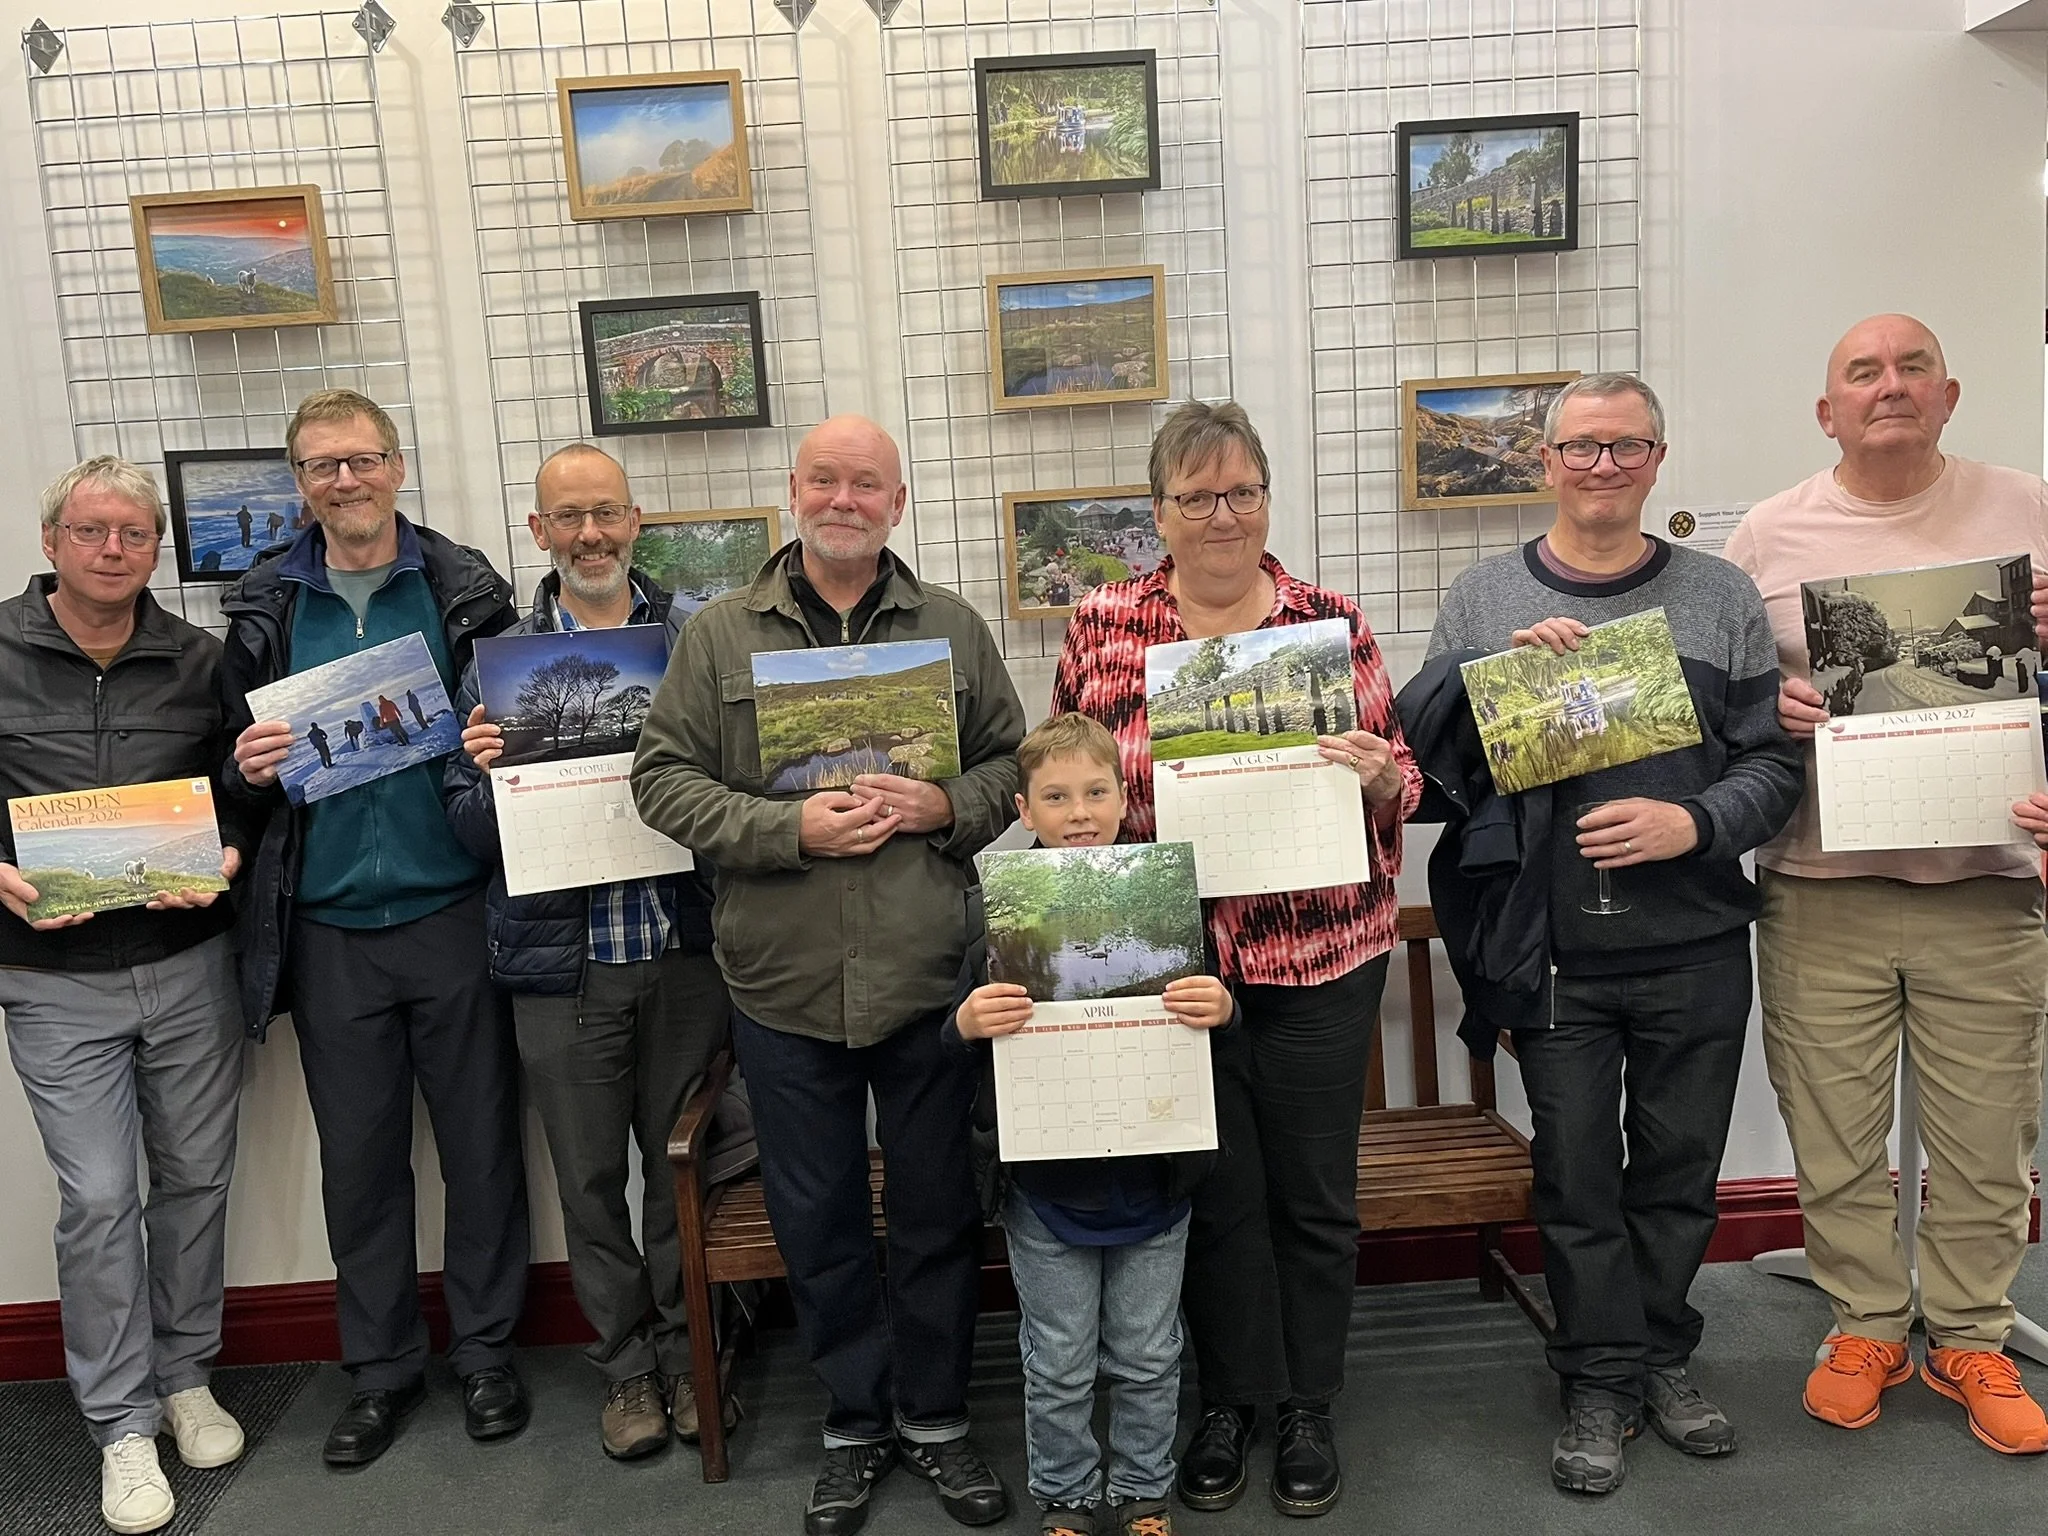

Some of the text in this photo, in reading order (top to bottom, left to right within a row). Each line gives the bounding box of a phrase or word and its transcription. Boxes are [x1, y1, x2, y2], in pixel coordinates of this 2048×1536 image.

[1880, 708, 1976, 727] JANUARY 2027
[1230, 752, 1281, 767] AUGUST
[559, 763, 615, 778] OCTOBER
[15, 792, 121, 820] MARSDEN
[18, 809, 122, 832] Calendar 2026
[119, 892, 147, 902] Marsden
[1081, 1005, 1118, 1018] APRIL
